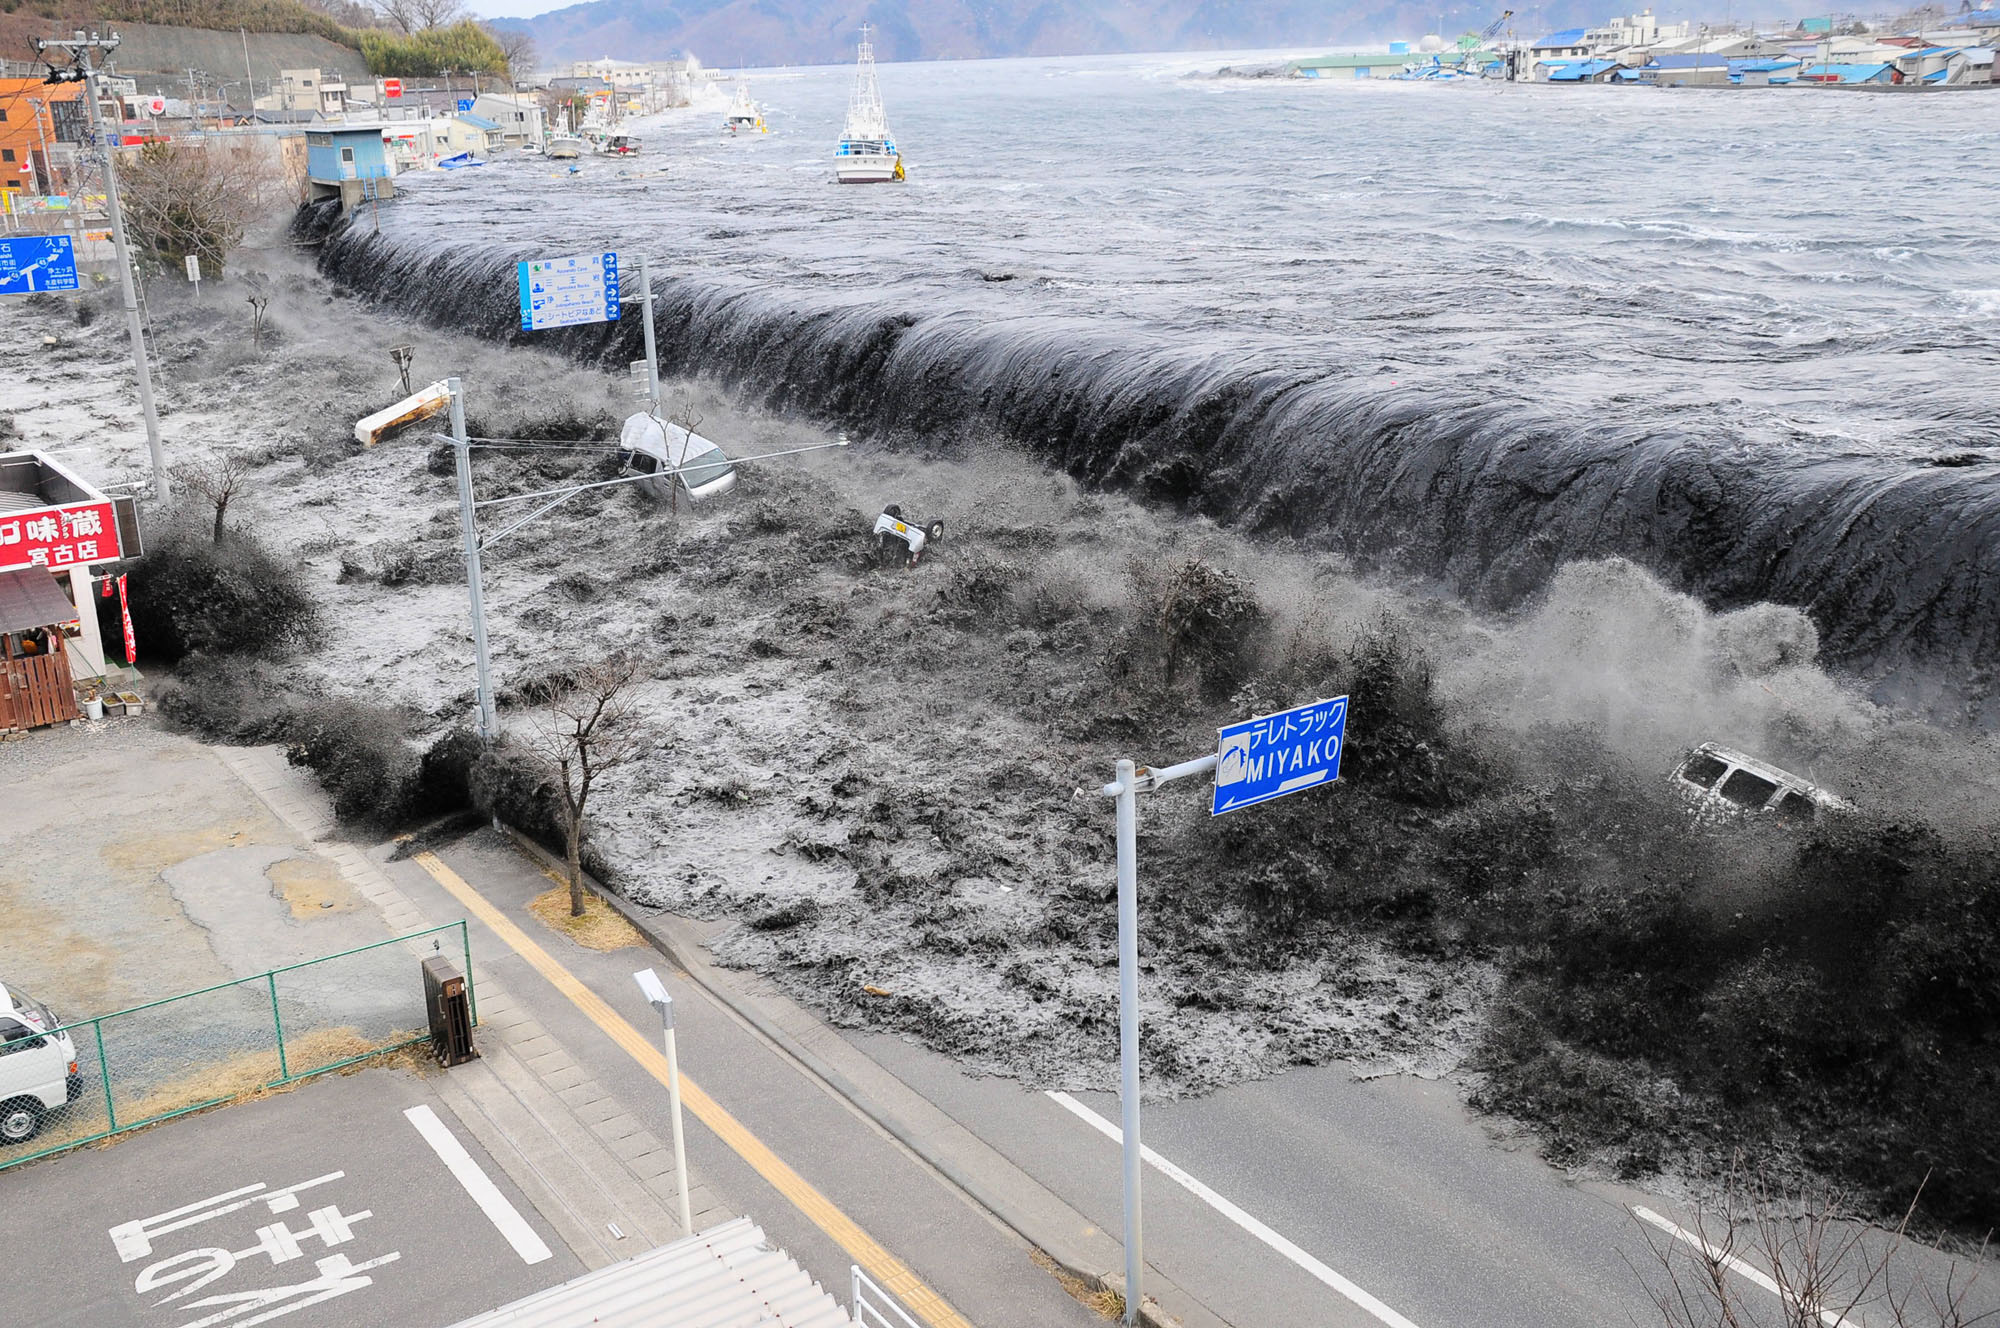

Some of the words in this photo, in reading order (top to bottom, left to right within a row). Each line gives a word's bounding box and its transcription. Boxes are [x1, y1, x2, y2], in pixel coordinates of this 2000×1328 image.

[28, 540, 98, 566] 宮古店
[1251, 702, 1345, 749] テレトラック
[1246, 735, 1339, 784] MIYAKO
